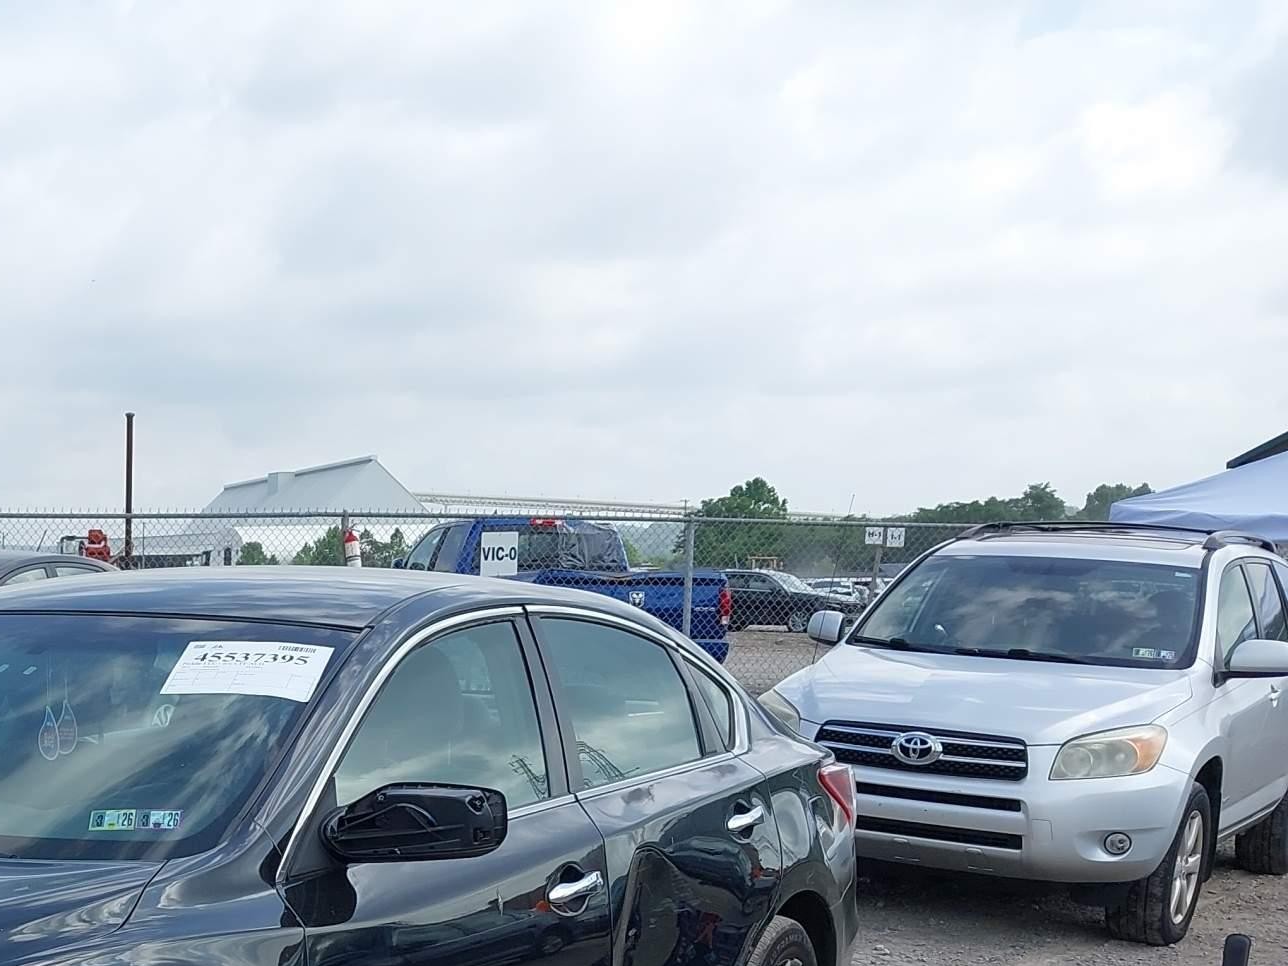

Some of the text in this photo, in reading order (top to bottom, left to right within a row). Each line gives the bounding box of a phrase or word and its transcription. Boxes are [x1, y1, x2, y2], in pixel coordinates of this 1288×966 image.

[194, 652, 312, 666] 45537395
[121, 812, 134, 827] 26
[166, 812, 180, 827] 26
